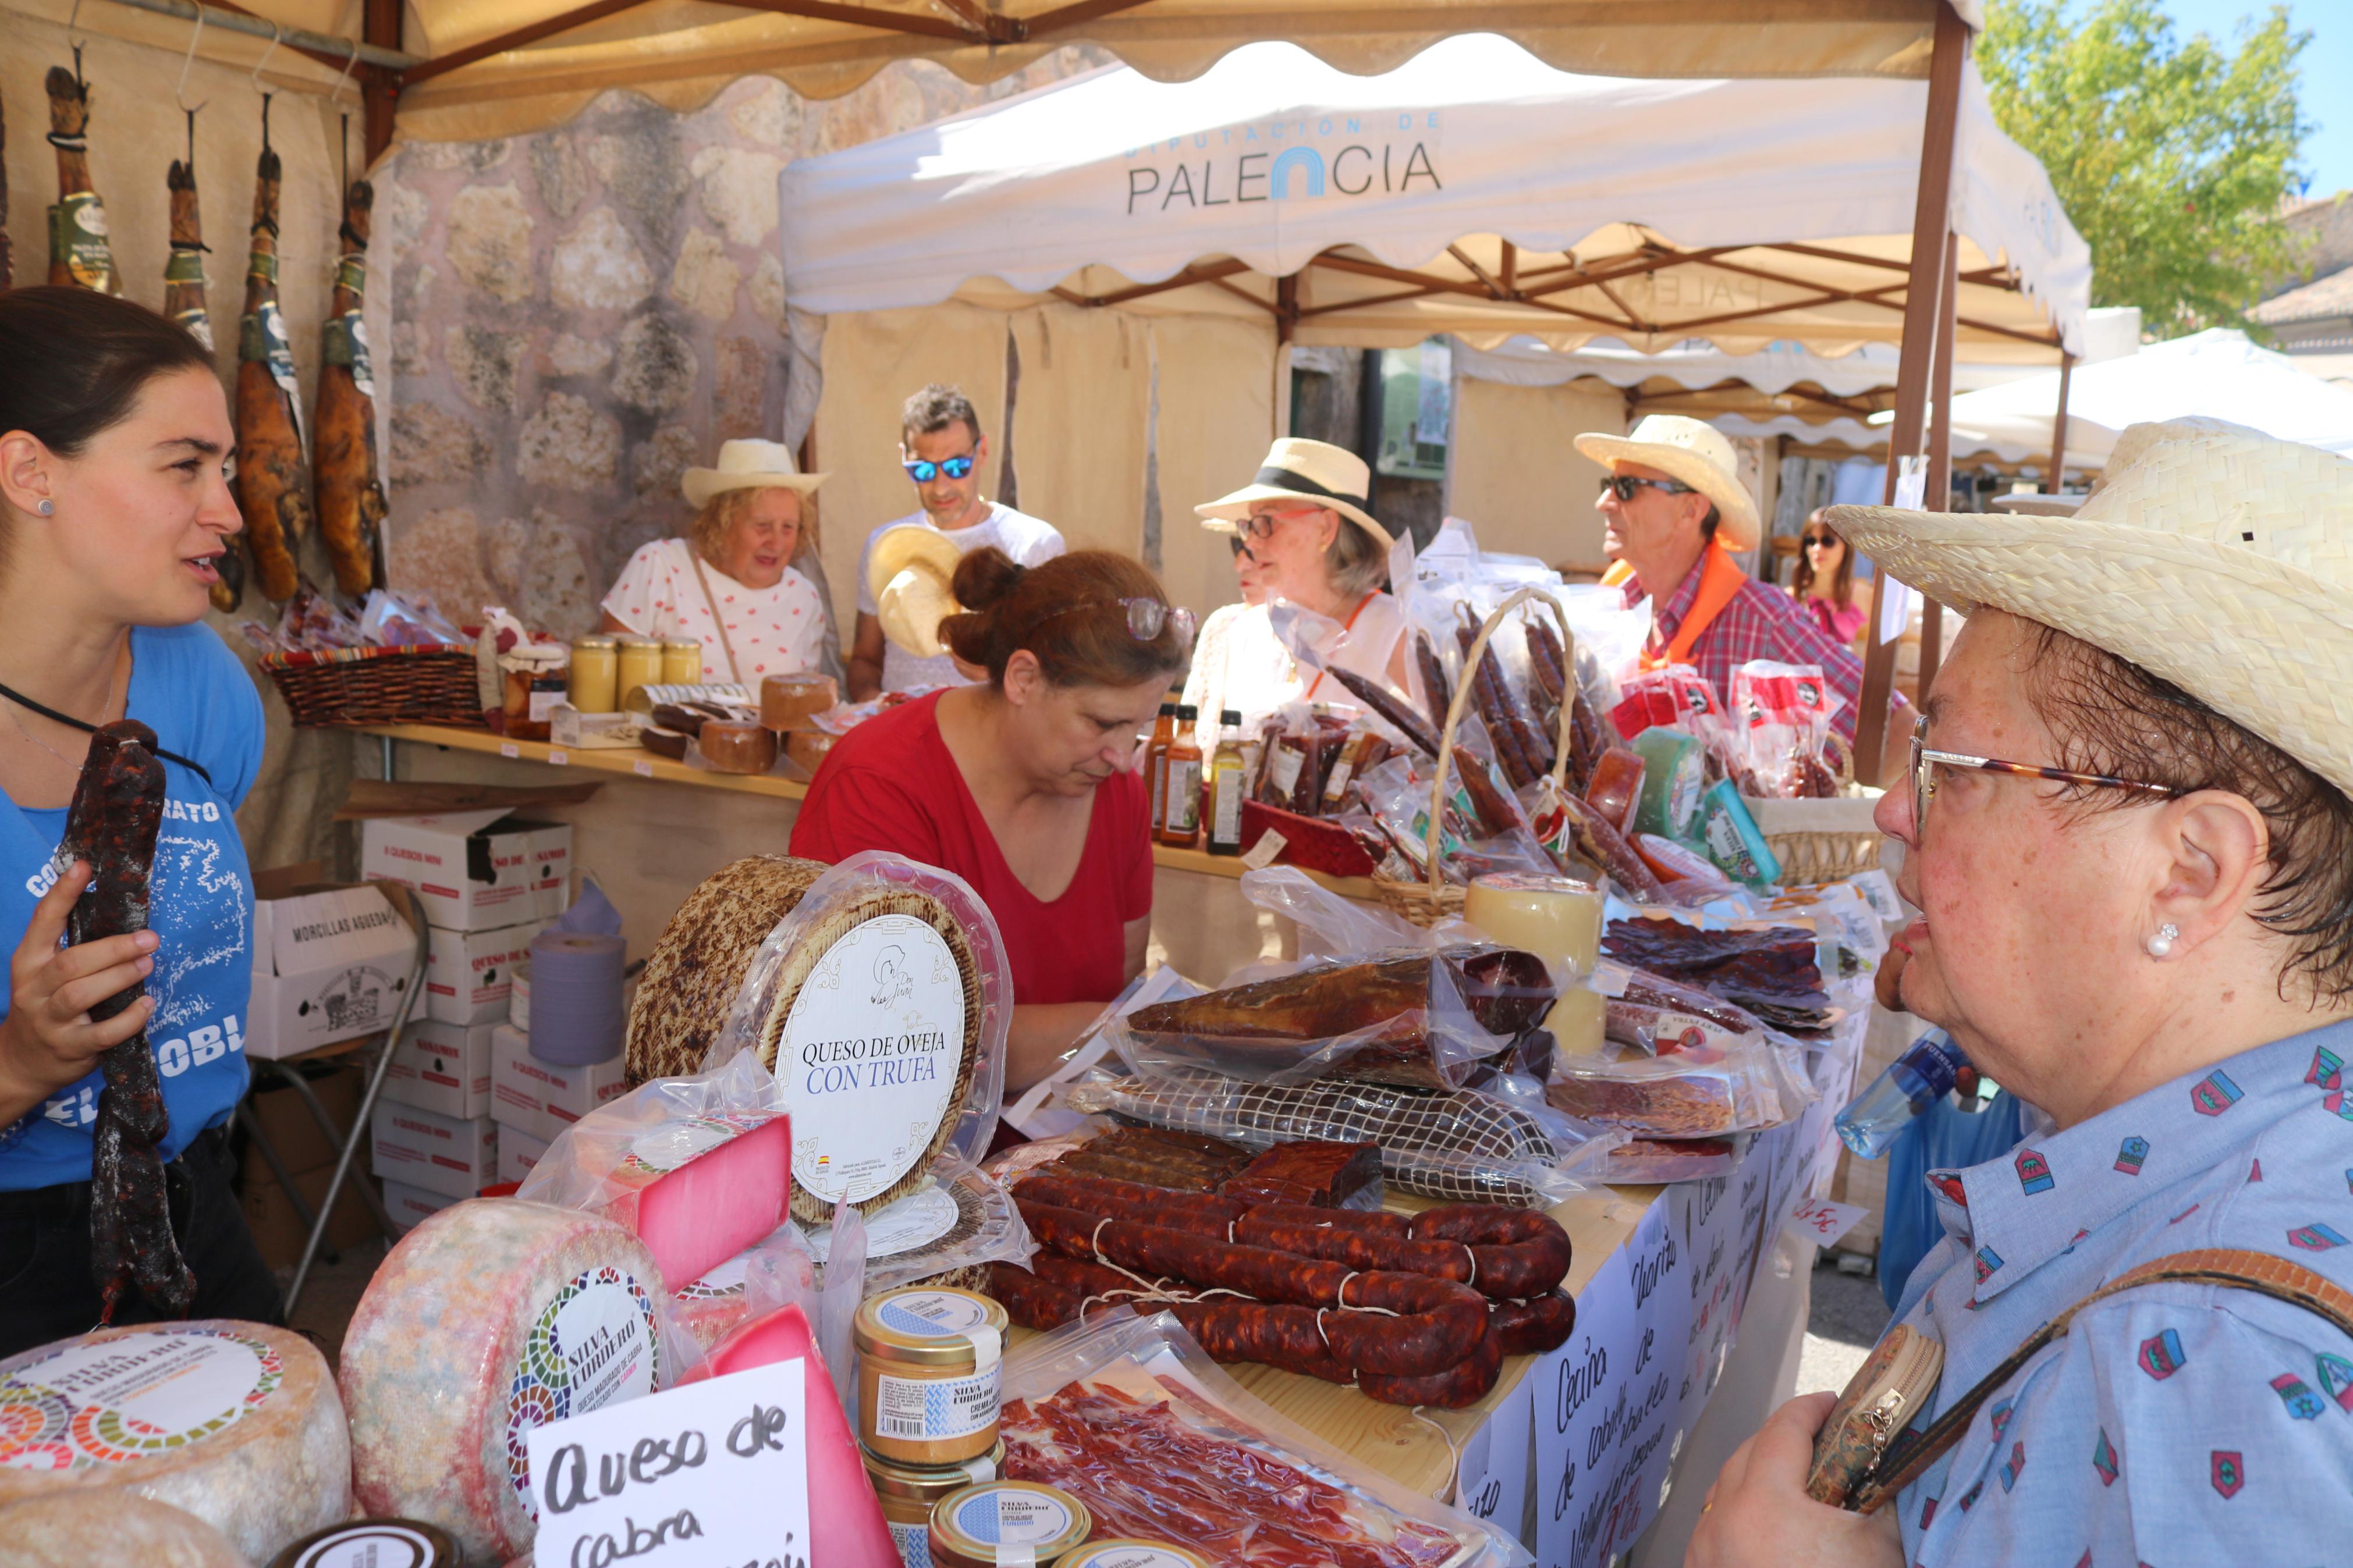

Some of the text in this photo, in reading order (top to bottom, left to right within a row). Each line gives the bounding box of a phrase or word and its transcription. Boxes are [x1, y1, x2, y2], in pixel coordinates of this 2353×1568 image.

[1399, 112, 1438, 130] DE
[292, 911, 389, 943] MORCILLAS AGUEDA
[898, 971, 913, 986] Don
[803, 1031, 946, 1067] QUESO DE OVEJA
[806, 1056, 936, 1094] CON TRUFA
[568, 1325, 609, 1373] SILVA
[572, 1319, 636, 1391] CORDERO
[1635, 1327, 1654, 1374] de
[577, 1342, 643, 1413] QUESO MADURADO DE CABRA
[611, 1380, 621, 1393] CON
[953, 1386, 993, 1405] CORDERO
[954, 1384, 981, 1396] SILVA
[1557, 1336, 1606, 1434] Cecina
[970, 1400, 989, 1414] CREMA
[726, 1403, 787, 1458] de
[1555, 1448, 1575, 1521] de
